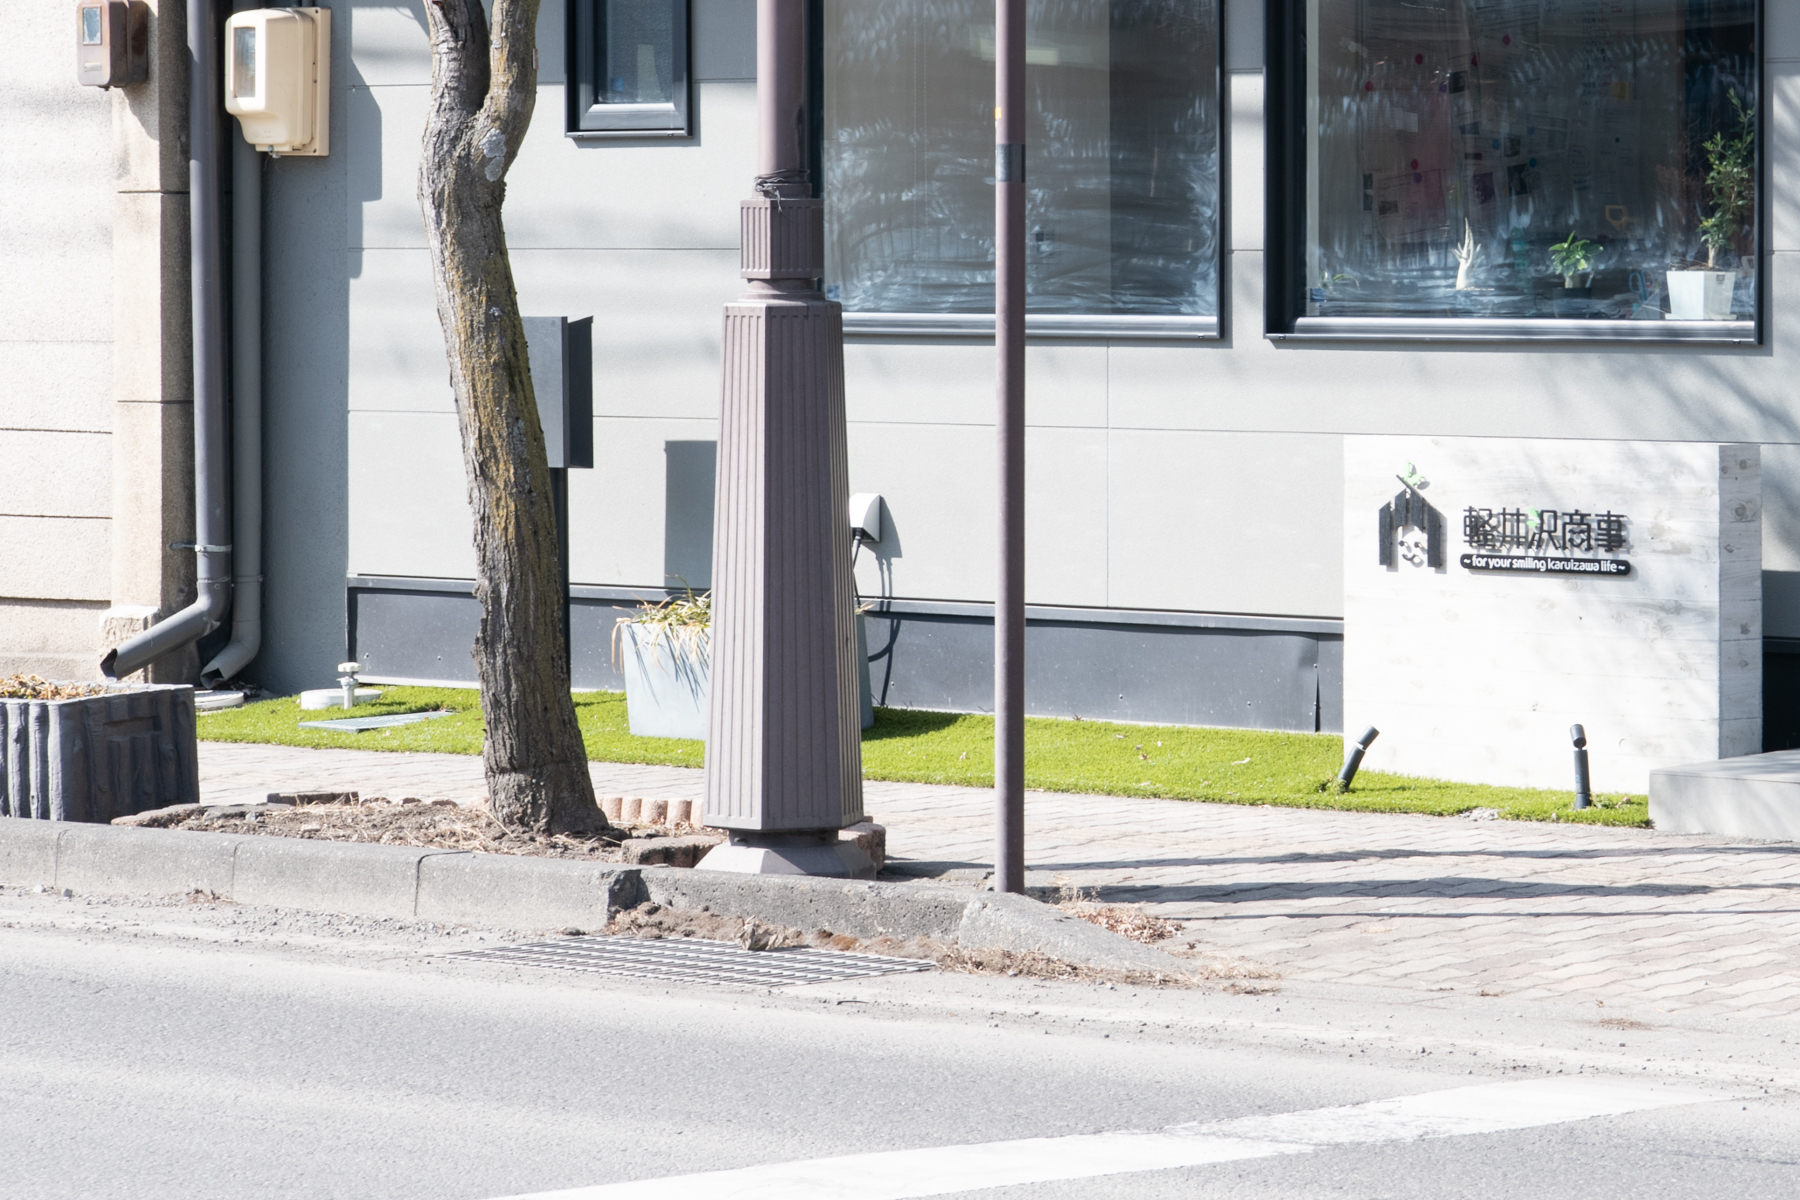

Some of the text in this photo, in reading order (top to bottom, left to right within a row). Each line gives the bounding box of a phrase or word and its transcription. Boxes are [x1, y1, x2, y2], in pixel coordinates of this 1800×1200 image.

[1463, 506, 1627, 552] 軽井沢商事
[1472, 555, 1487, 567] for
[1488, 558, 1511, 570] your
[1512, 558, 1546, 572] smiling
[1548, 558, 1600, 572] karuizawa
[1601, 560, 1617, 572] life
